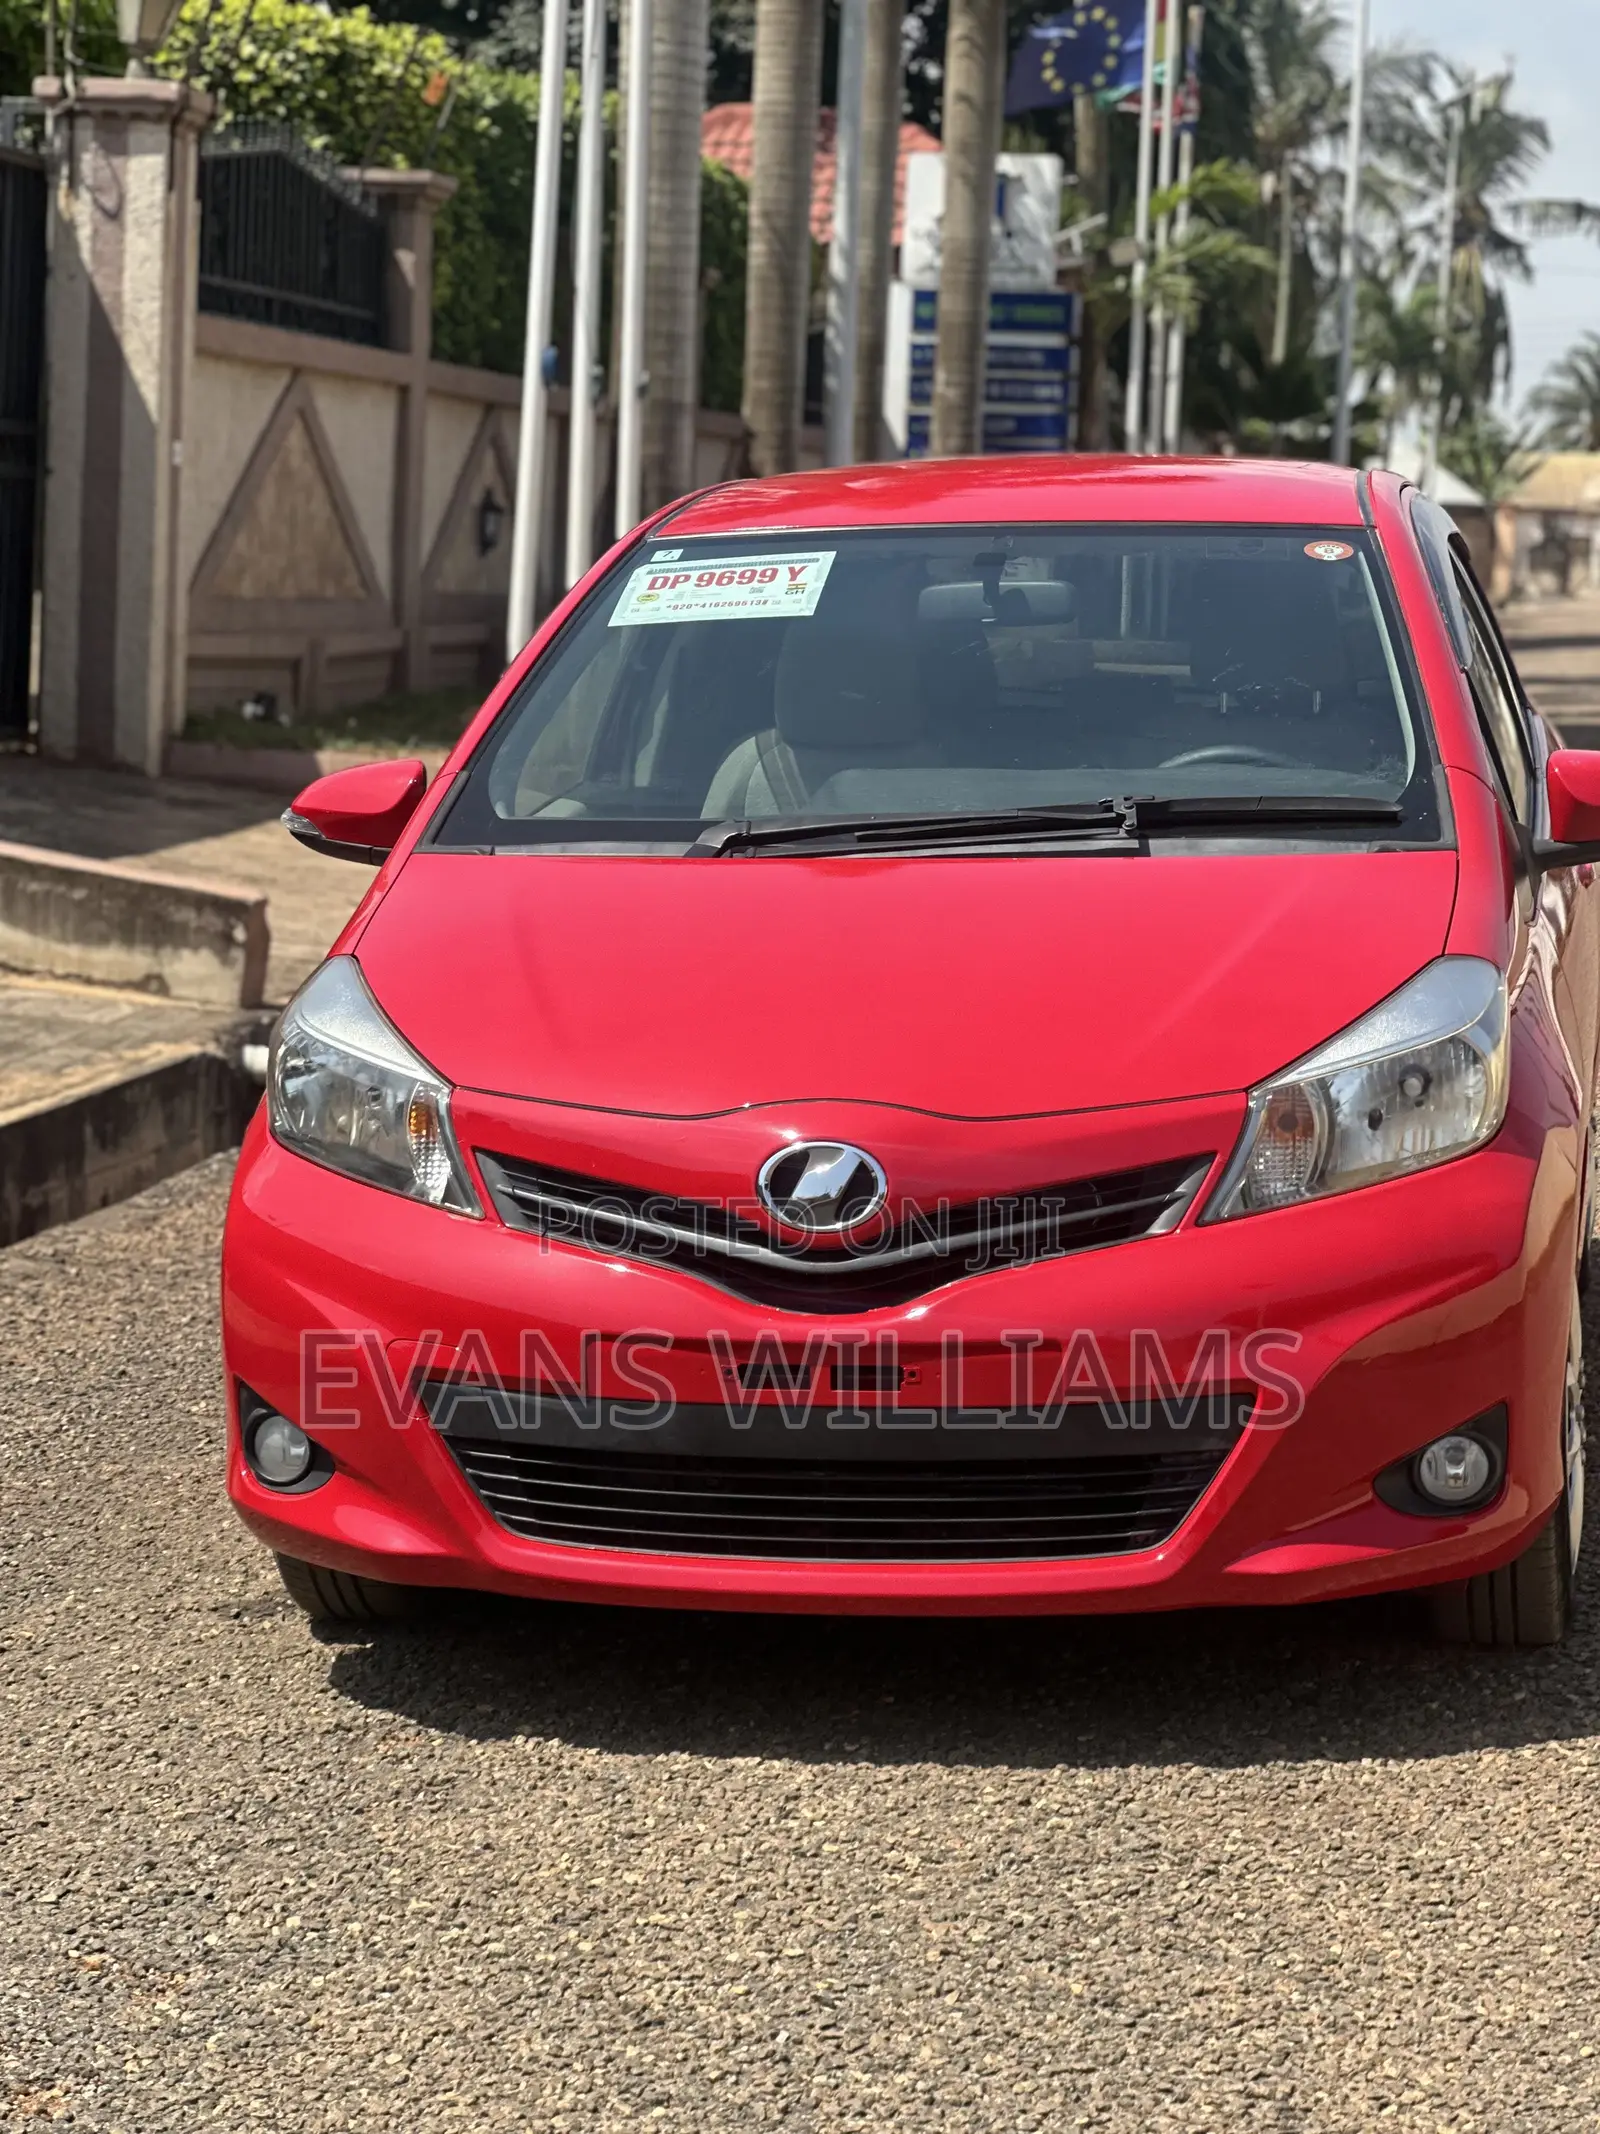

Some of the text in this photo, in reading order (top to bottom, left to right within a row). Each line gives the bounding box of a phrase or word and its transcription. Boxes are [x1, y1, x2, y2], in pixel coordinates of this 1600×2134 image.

[646, 575, 692, 591] DP
[693, 567, 780, 588] 9699
[787, 565, 809, 582] Y
